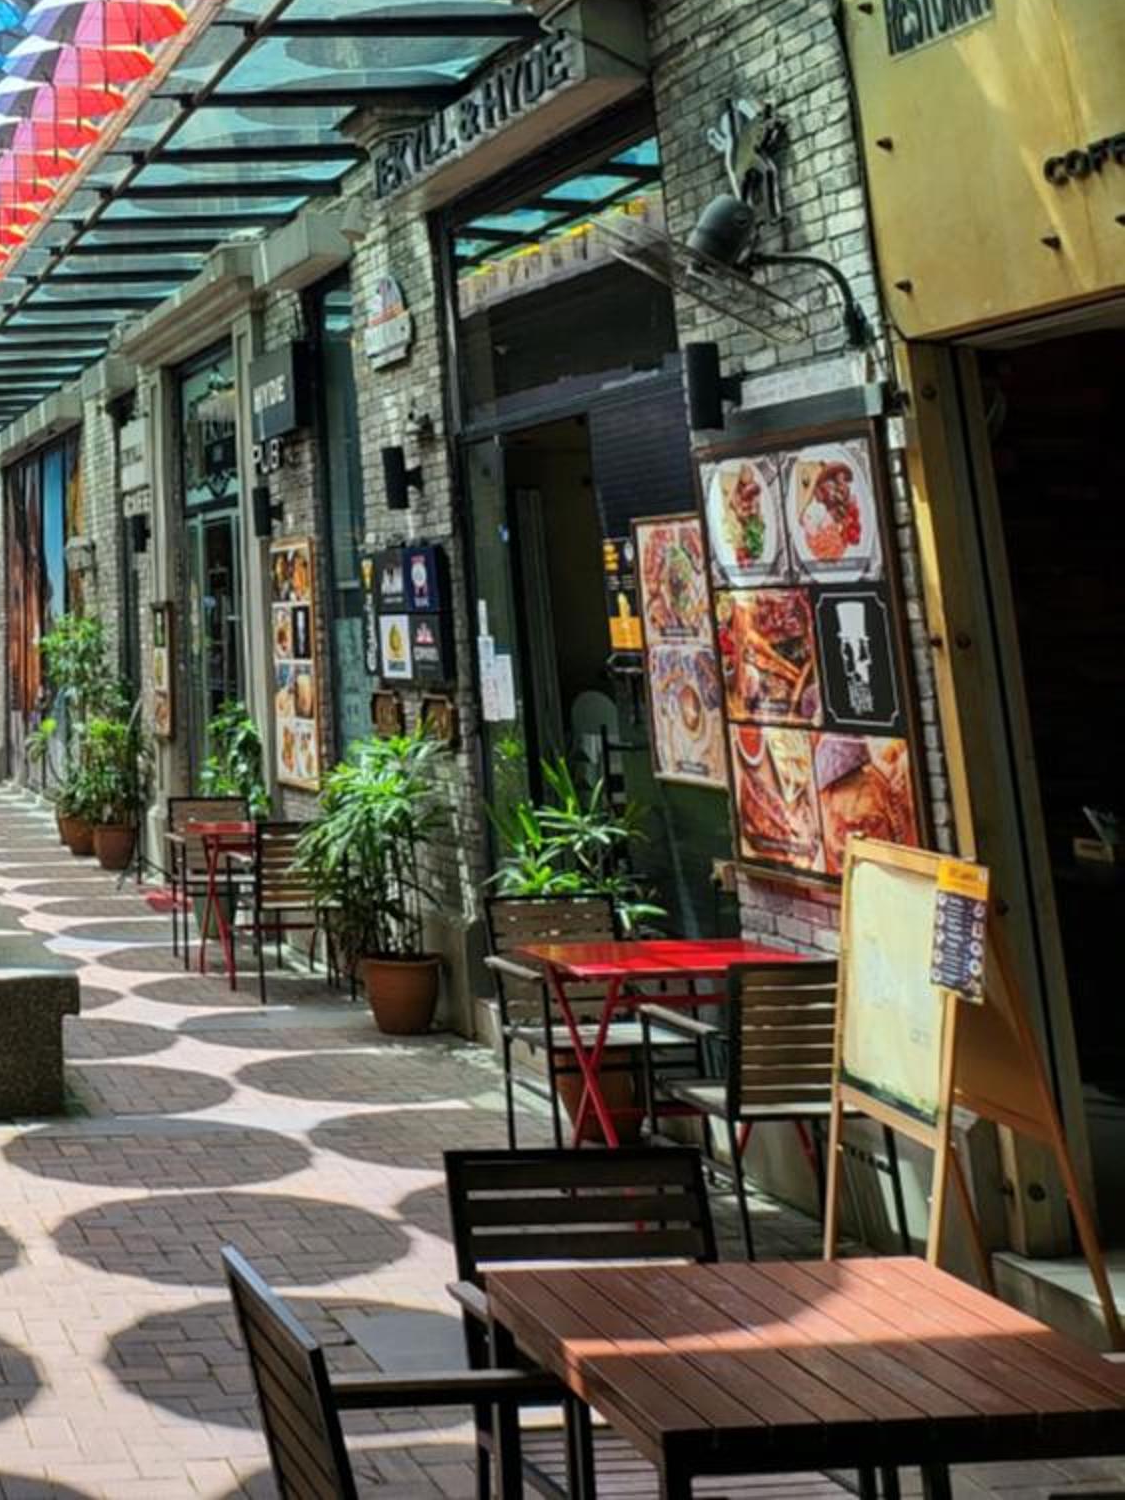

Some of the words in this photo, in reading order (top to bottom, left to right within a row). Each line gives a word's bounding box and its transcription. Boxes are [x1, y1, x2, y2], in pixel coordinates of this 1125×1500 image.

[459, 99, 480, 142] &
[482, 28, 570, 129] HYDE
[254, 374, 286, 414] HYDE
[251, 438, 280, 474] PUB
